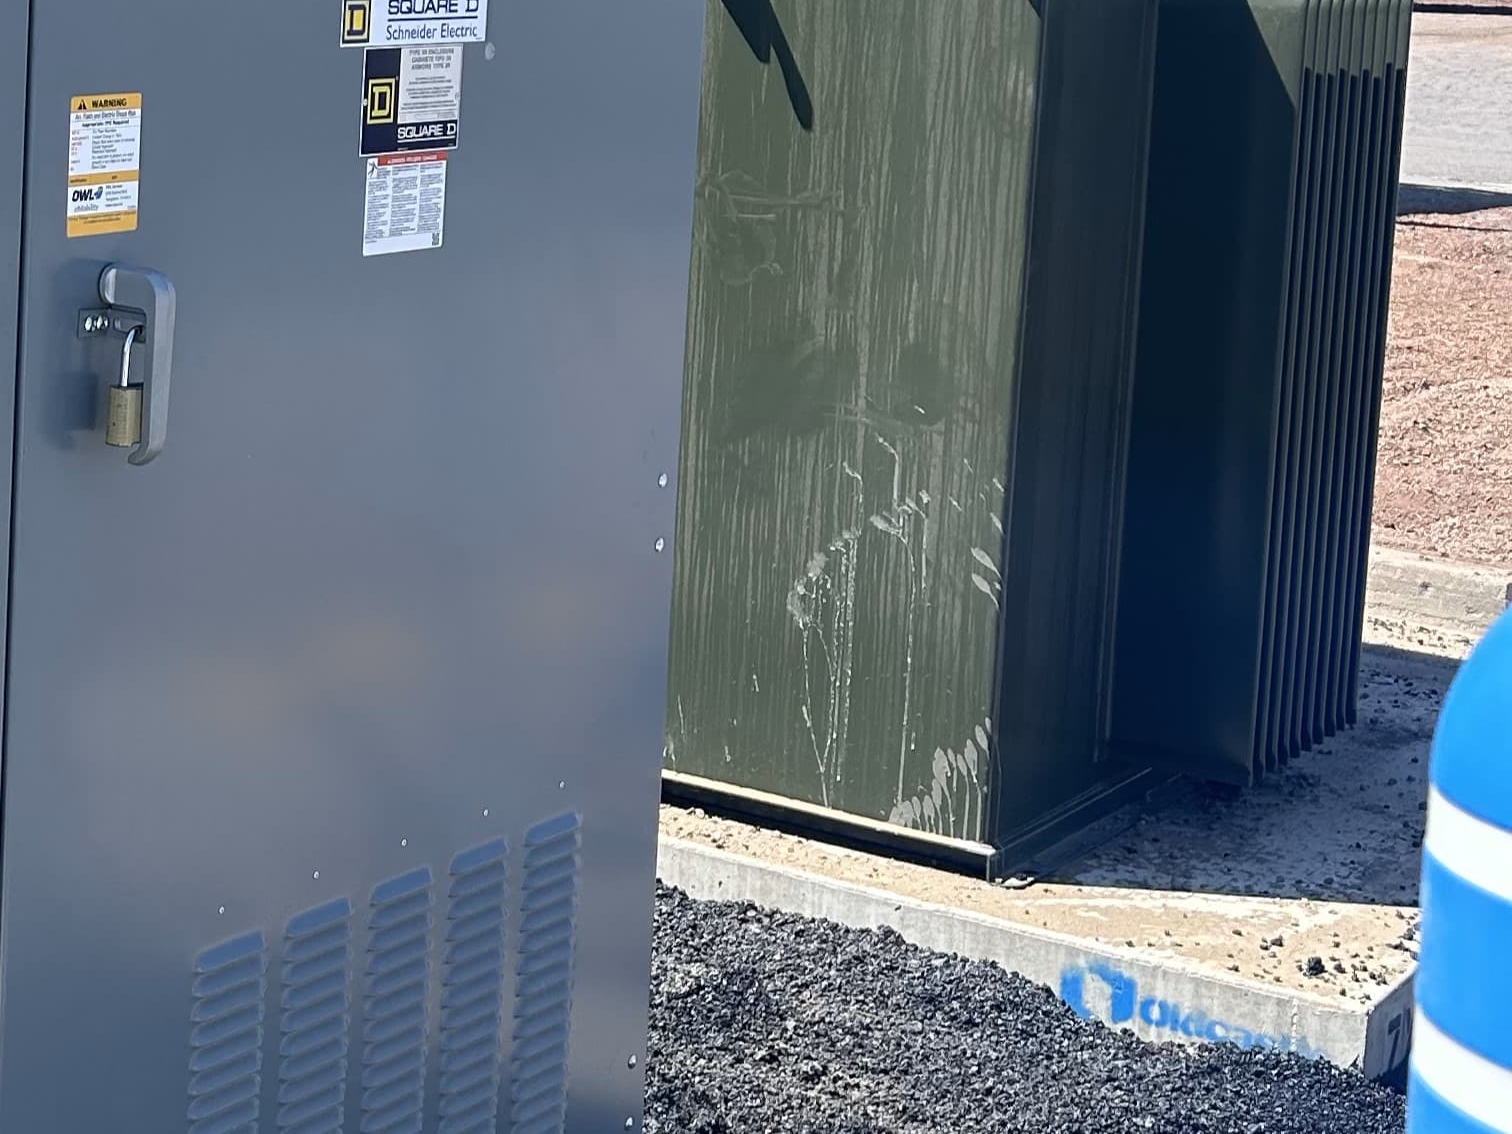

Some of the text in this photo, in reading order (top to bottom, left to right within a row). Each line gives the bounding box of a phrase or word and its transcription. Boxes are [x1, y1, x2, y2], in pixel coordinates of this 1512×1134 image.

[386, 23, 477, 41] Schneider Electric
[92, 98, 127, 108] WARNING
[397, 123, 456, 140] SQUARE D
[72, 189, 95, 202] OWL
